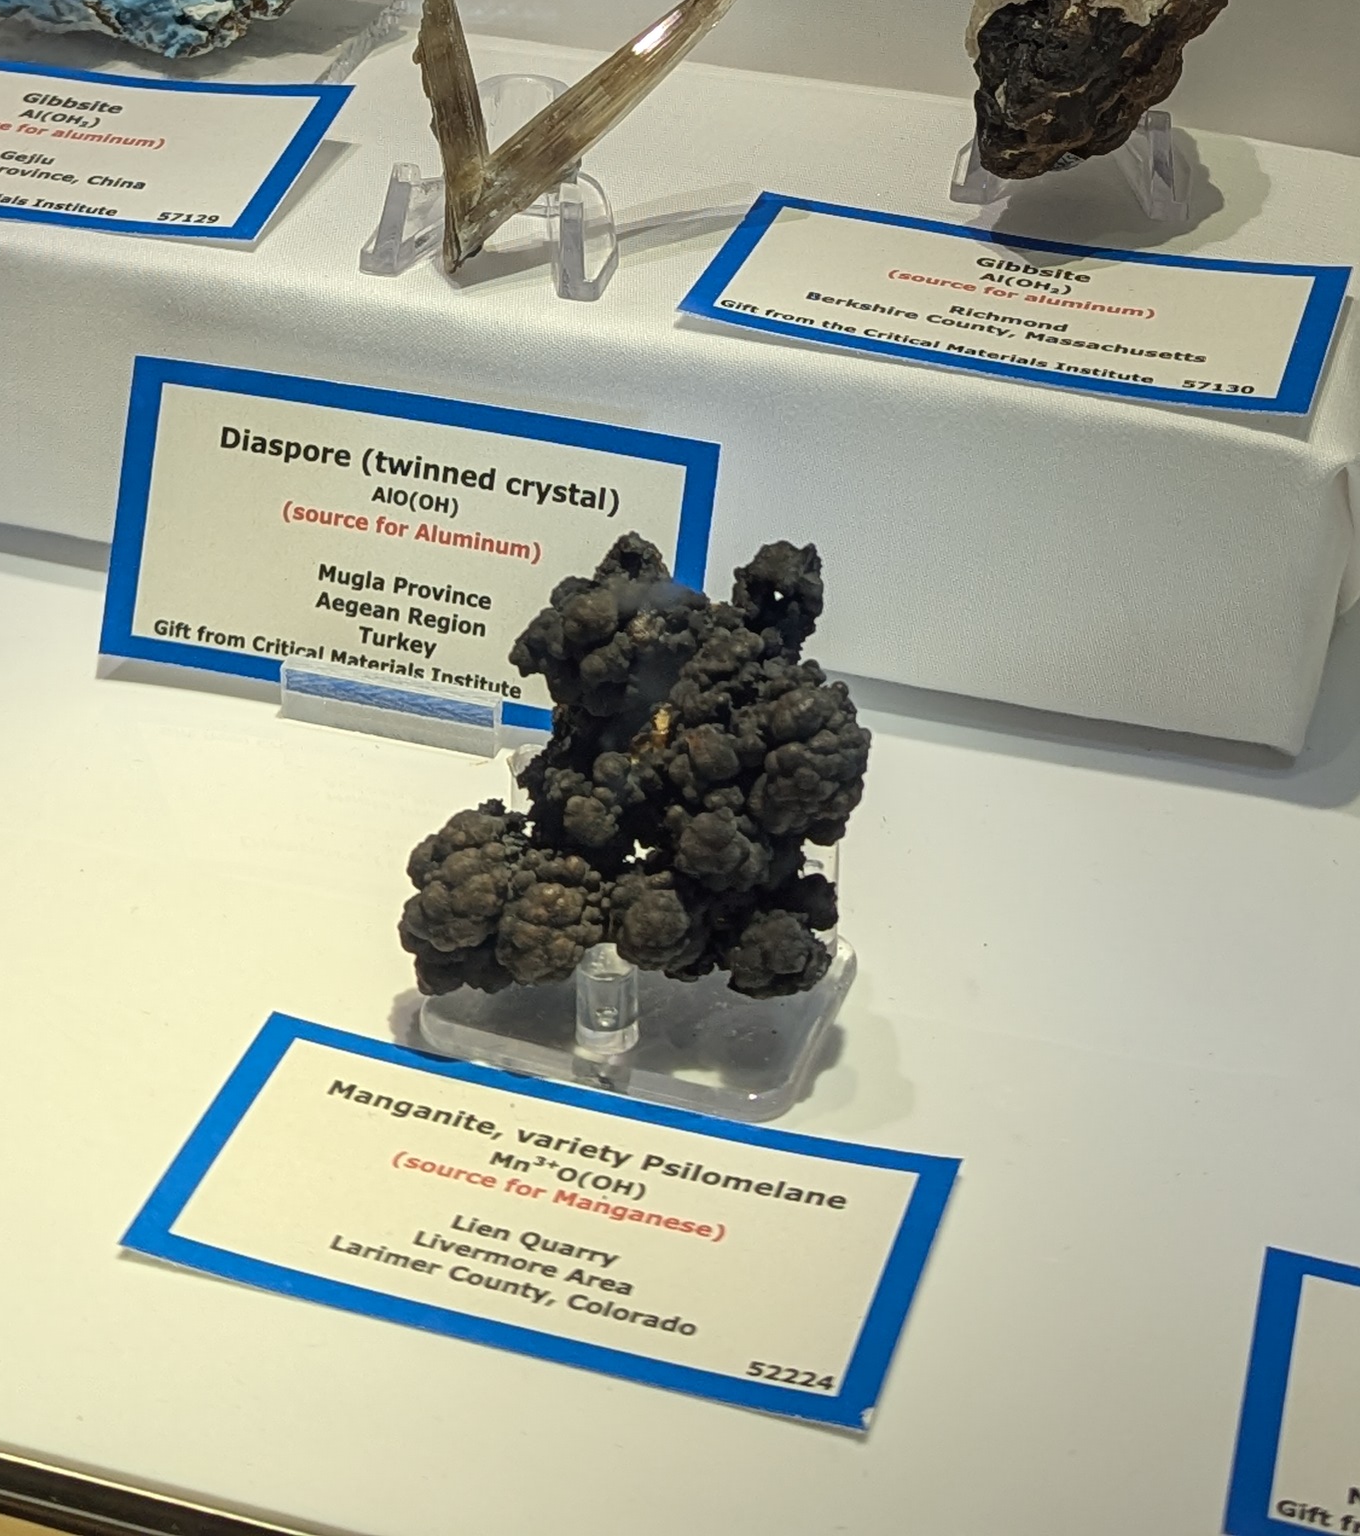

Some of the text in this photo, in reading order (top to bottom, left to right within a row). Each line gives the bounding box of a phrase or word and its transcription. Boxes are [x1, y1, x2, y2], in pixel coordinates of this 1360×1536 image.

[22, 92, 123, 114] Gibbsite
[15, 122, 49, 136] for
[50, 128, 165, 150] aluminum)
[86, 174, 146, 190] China
[31, 198, 118, 217] Institute
[976, 257, 1091, 283] Gibbsite
[887, 269, 1155, 320] (source for aluminum)
[720, 299, 857, 334] Gift from the
[805, 291, 1206, 363] Berkshire County, Massachusetts
[948, 305, 1068, 332] Richmond
[220, 426, 619, 518] Diaspore (twinned crystal)
[371, 486, 459, 519] AlO(OH)
[282, 500, 541, 565] (source for Aluminum)
[317, 563, 492, 610] Mugla Province
[153, 619, 192, 640] Gift
[315, 591, 486, 637] Aegean Region
[358, 625, 437, 659] Turkey
[327, 1080, 846, 1210] Manganite, variety Psilomelane
[391, 1150, 725, 1242] (source for Manganese)
[450, 1214, 619, 1268] Lien Quarry
[329, 1234, 555, 1307] Larimer County,
[412, 1230, 633, 1296] Livermore Area
[1276, 1499, 1332, 1527] Gift
